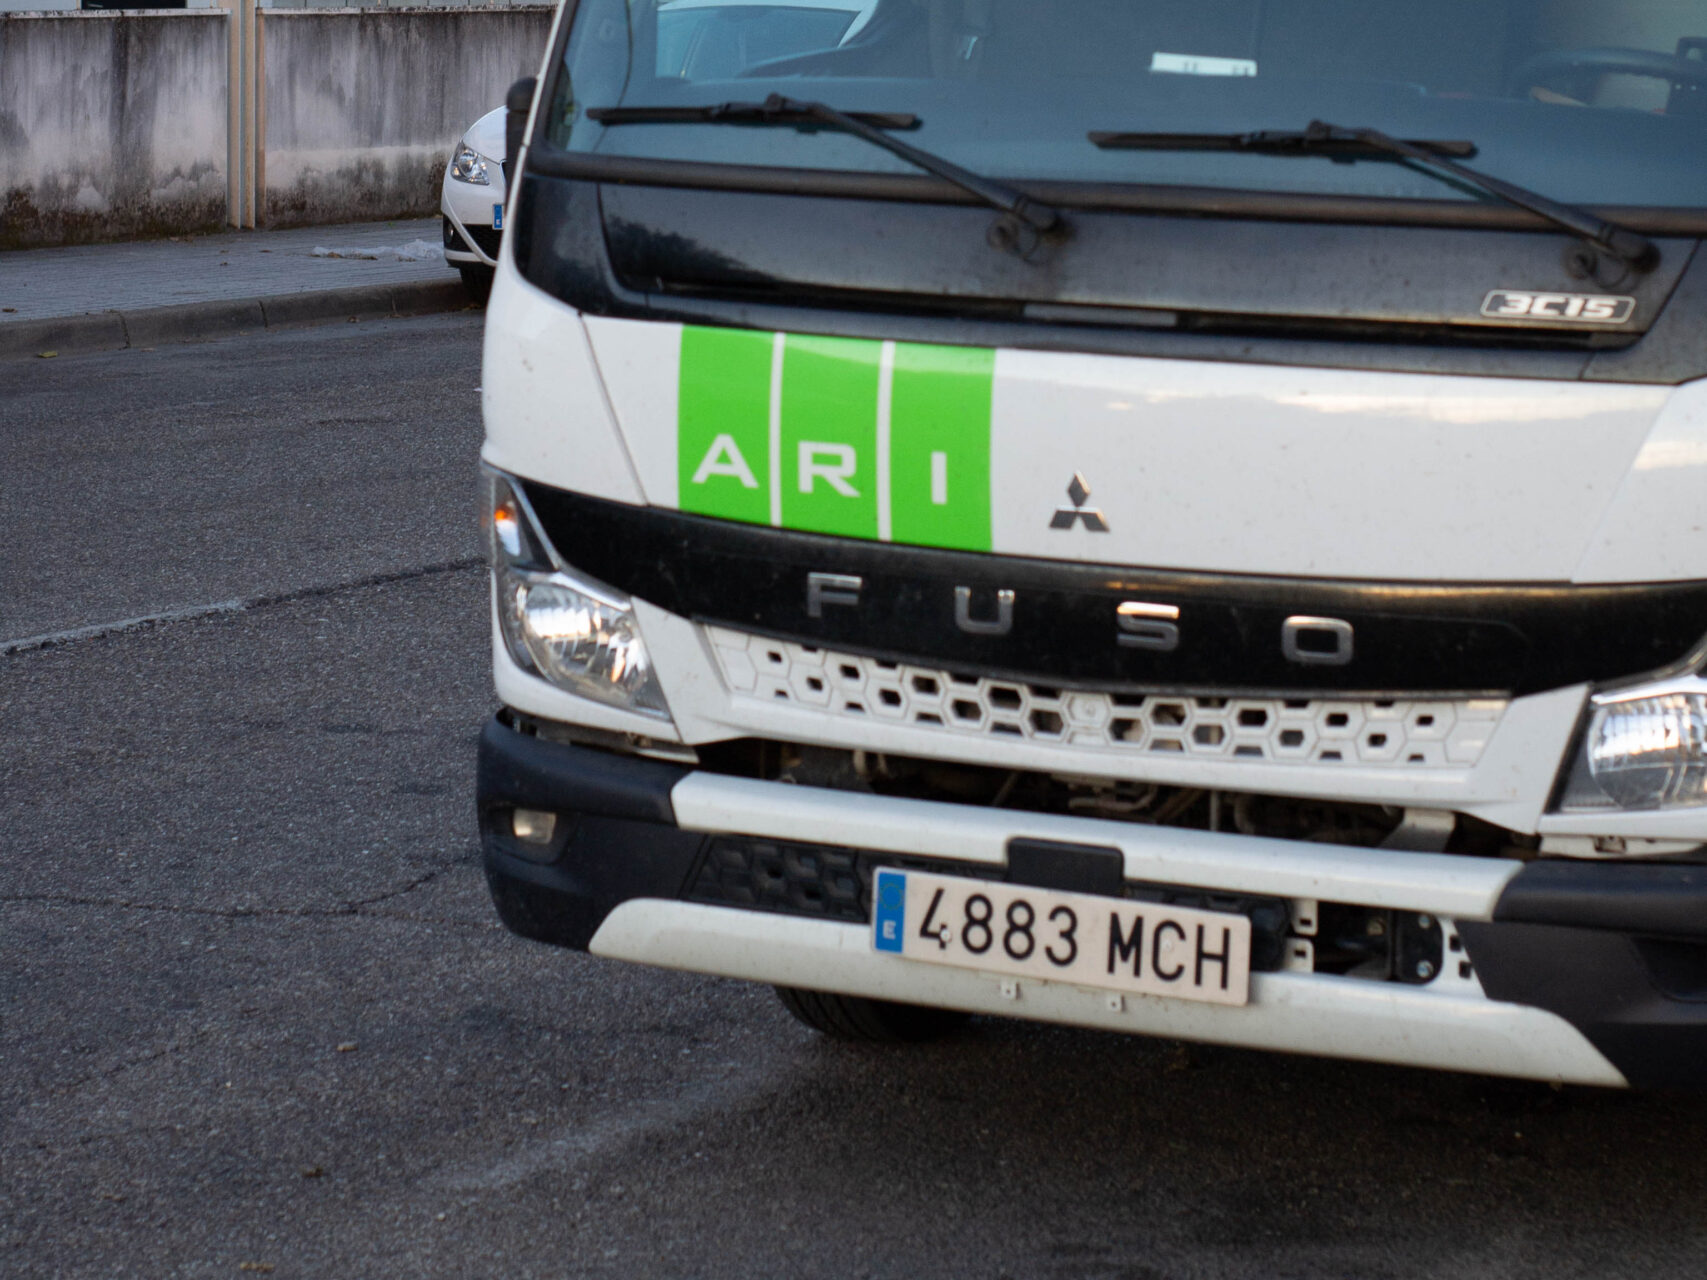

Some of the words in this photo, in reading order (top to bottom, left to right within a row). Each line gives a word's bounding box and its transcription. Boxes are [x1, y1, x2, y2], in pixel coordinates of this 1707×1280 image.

[692, 434, 948, 505] ARI
[808, 572, 1354, 665] FUSO
[883, 920, 897, 940] E
[919, 888, 1078, 967] 4883
[1107, 912, 1231, 990] MCH
